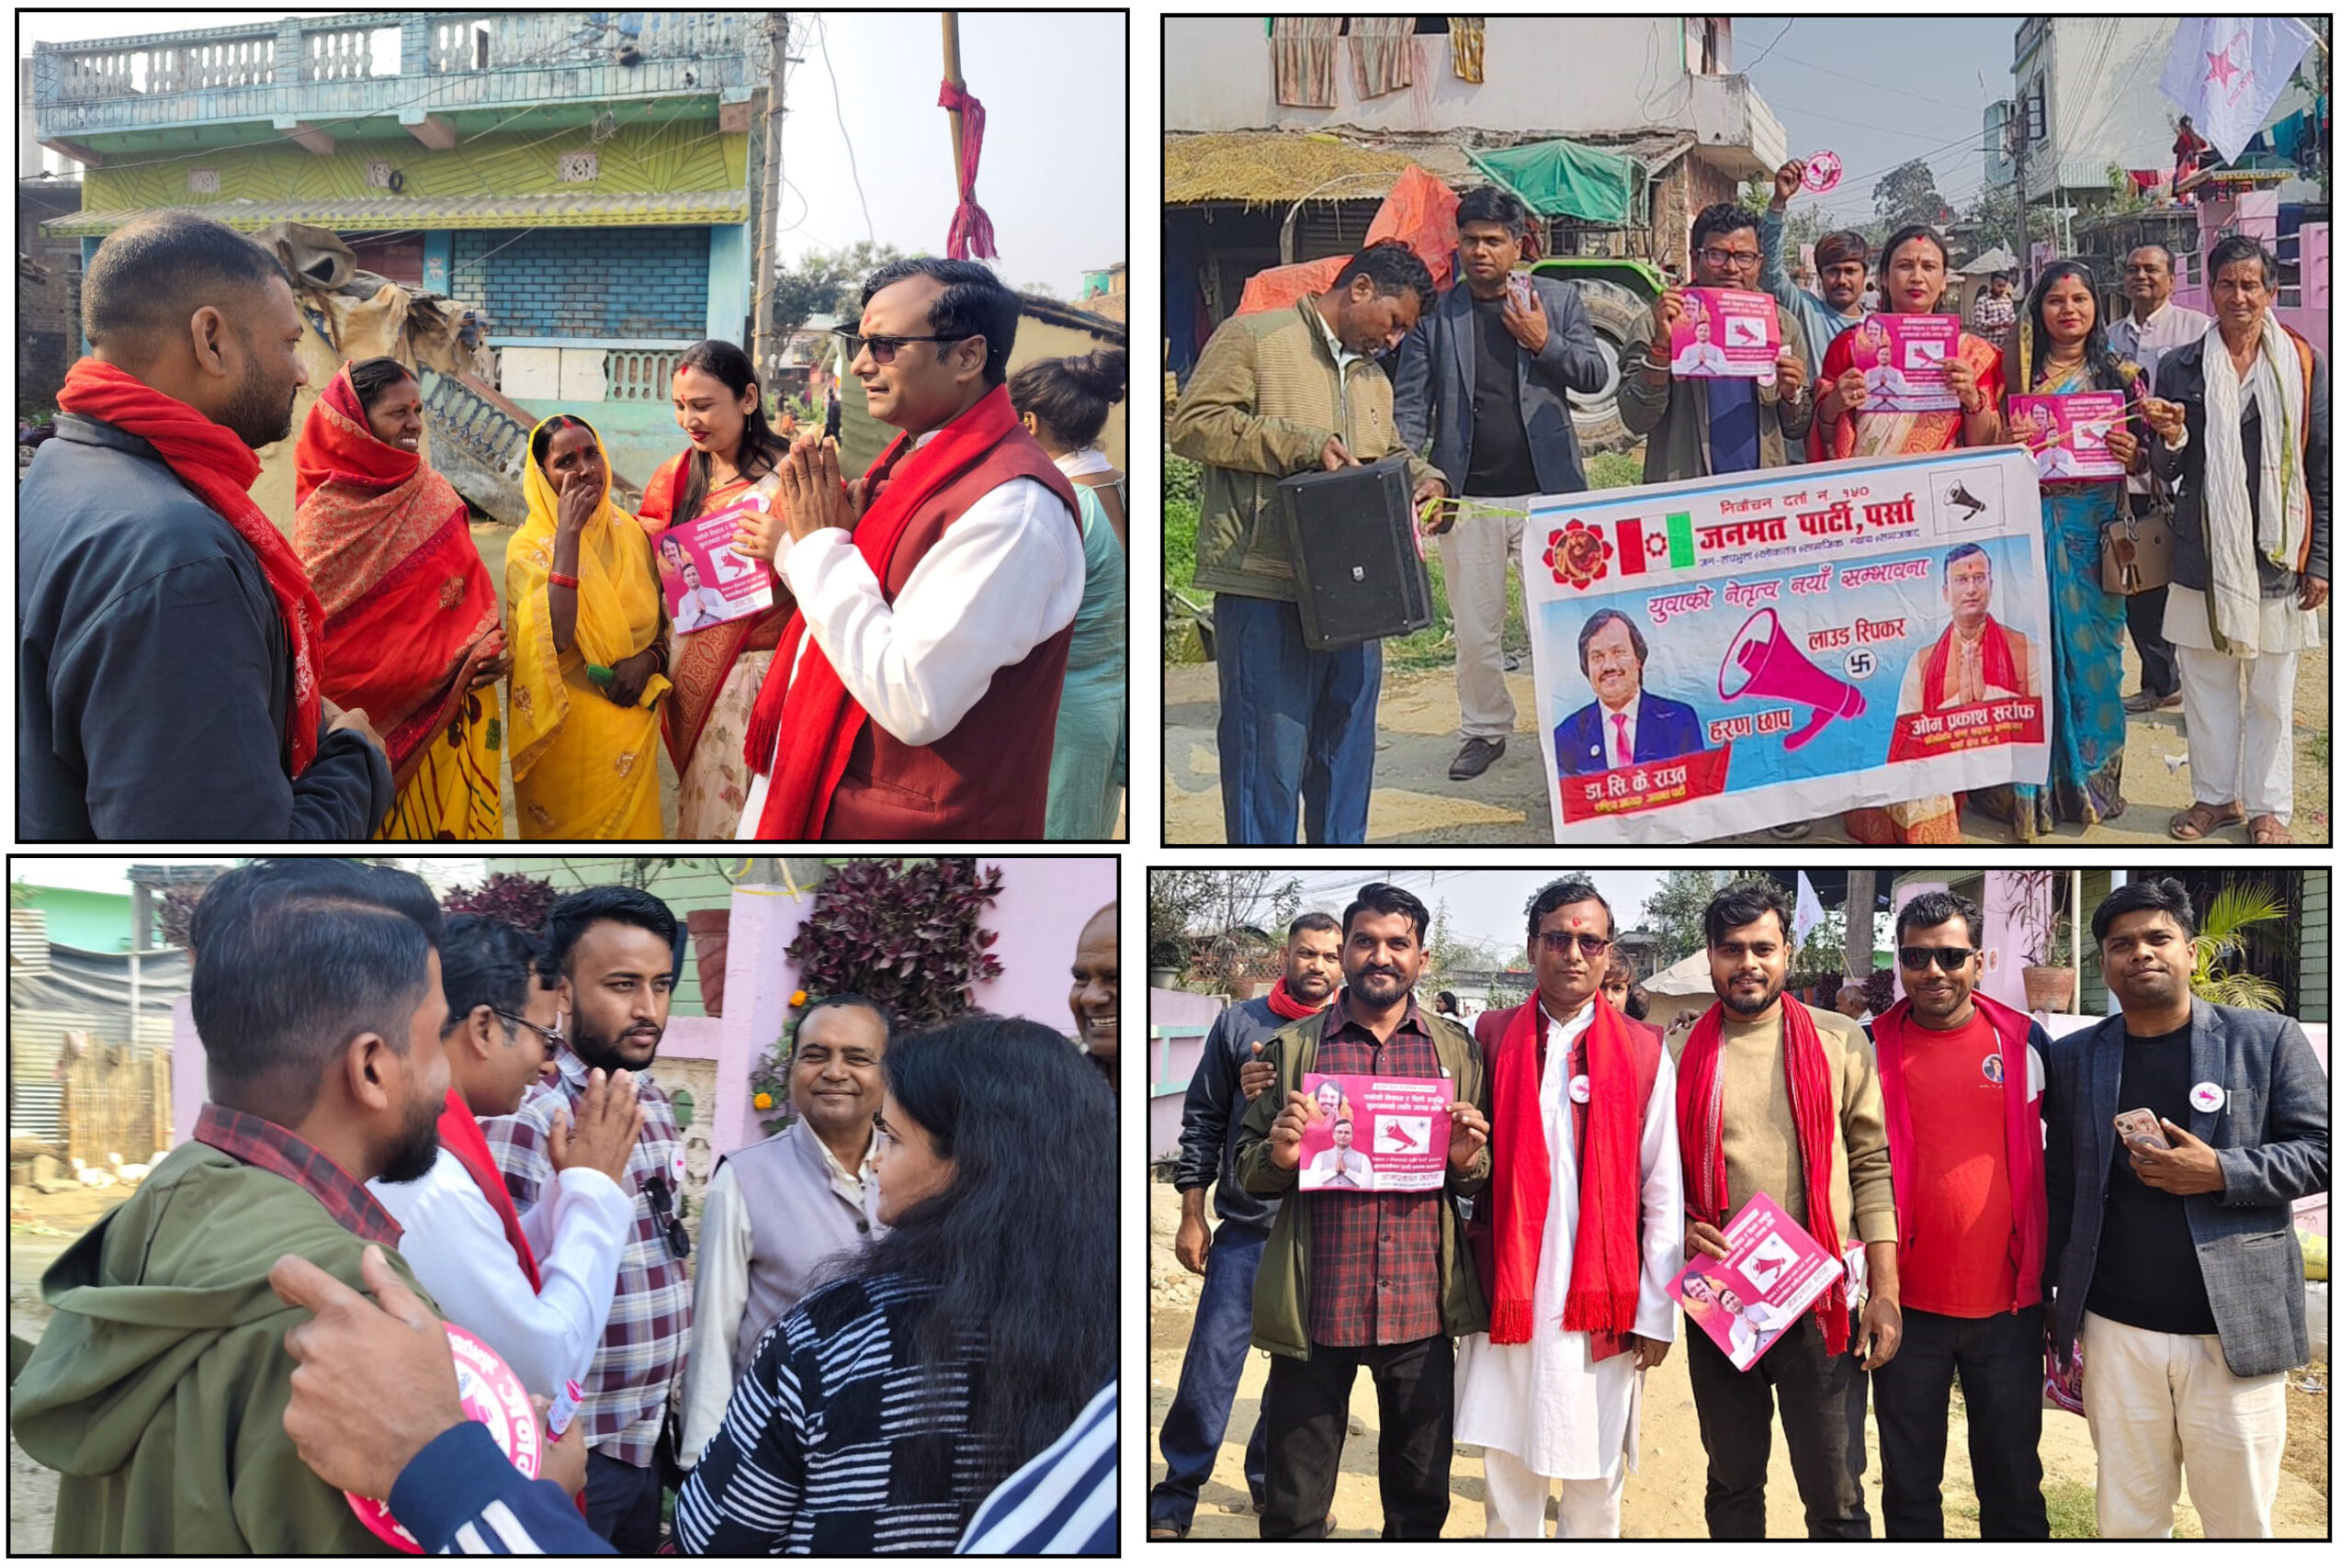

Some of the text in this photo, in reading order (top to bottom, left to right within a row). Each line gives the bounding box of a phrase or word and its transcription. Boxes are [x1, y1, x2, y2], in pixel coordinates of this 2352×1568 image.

[1720, 498, 1772, 514] निर्वाचन
[1781, 490, 1807, 506] दर्ता
[1695, 516, 1787, 550] जनमत
[1862, 492, 1916, 527] पर्सा
[1649, 559, 1928, 622] युवाको नेतृत्व नयाँ सम्भावना
[1808, 617, 1906, 650] लाउड स्पिकर
[1710, 709, 1792, 741] हरण छाप
[1911, 701, 2036, 735] ओम प्रकाश सर्राफ
[1584, 783, 1604, 800] डा.
[1632, 770, 1650, 792] के.
[1652, 765, 1687, 788] राउत
